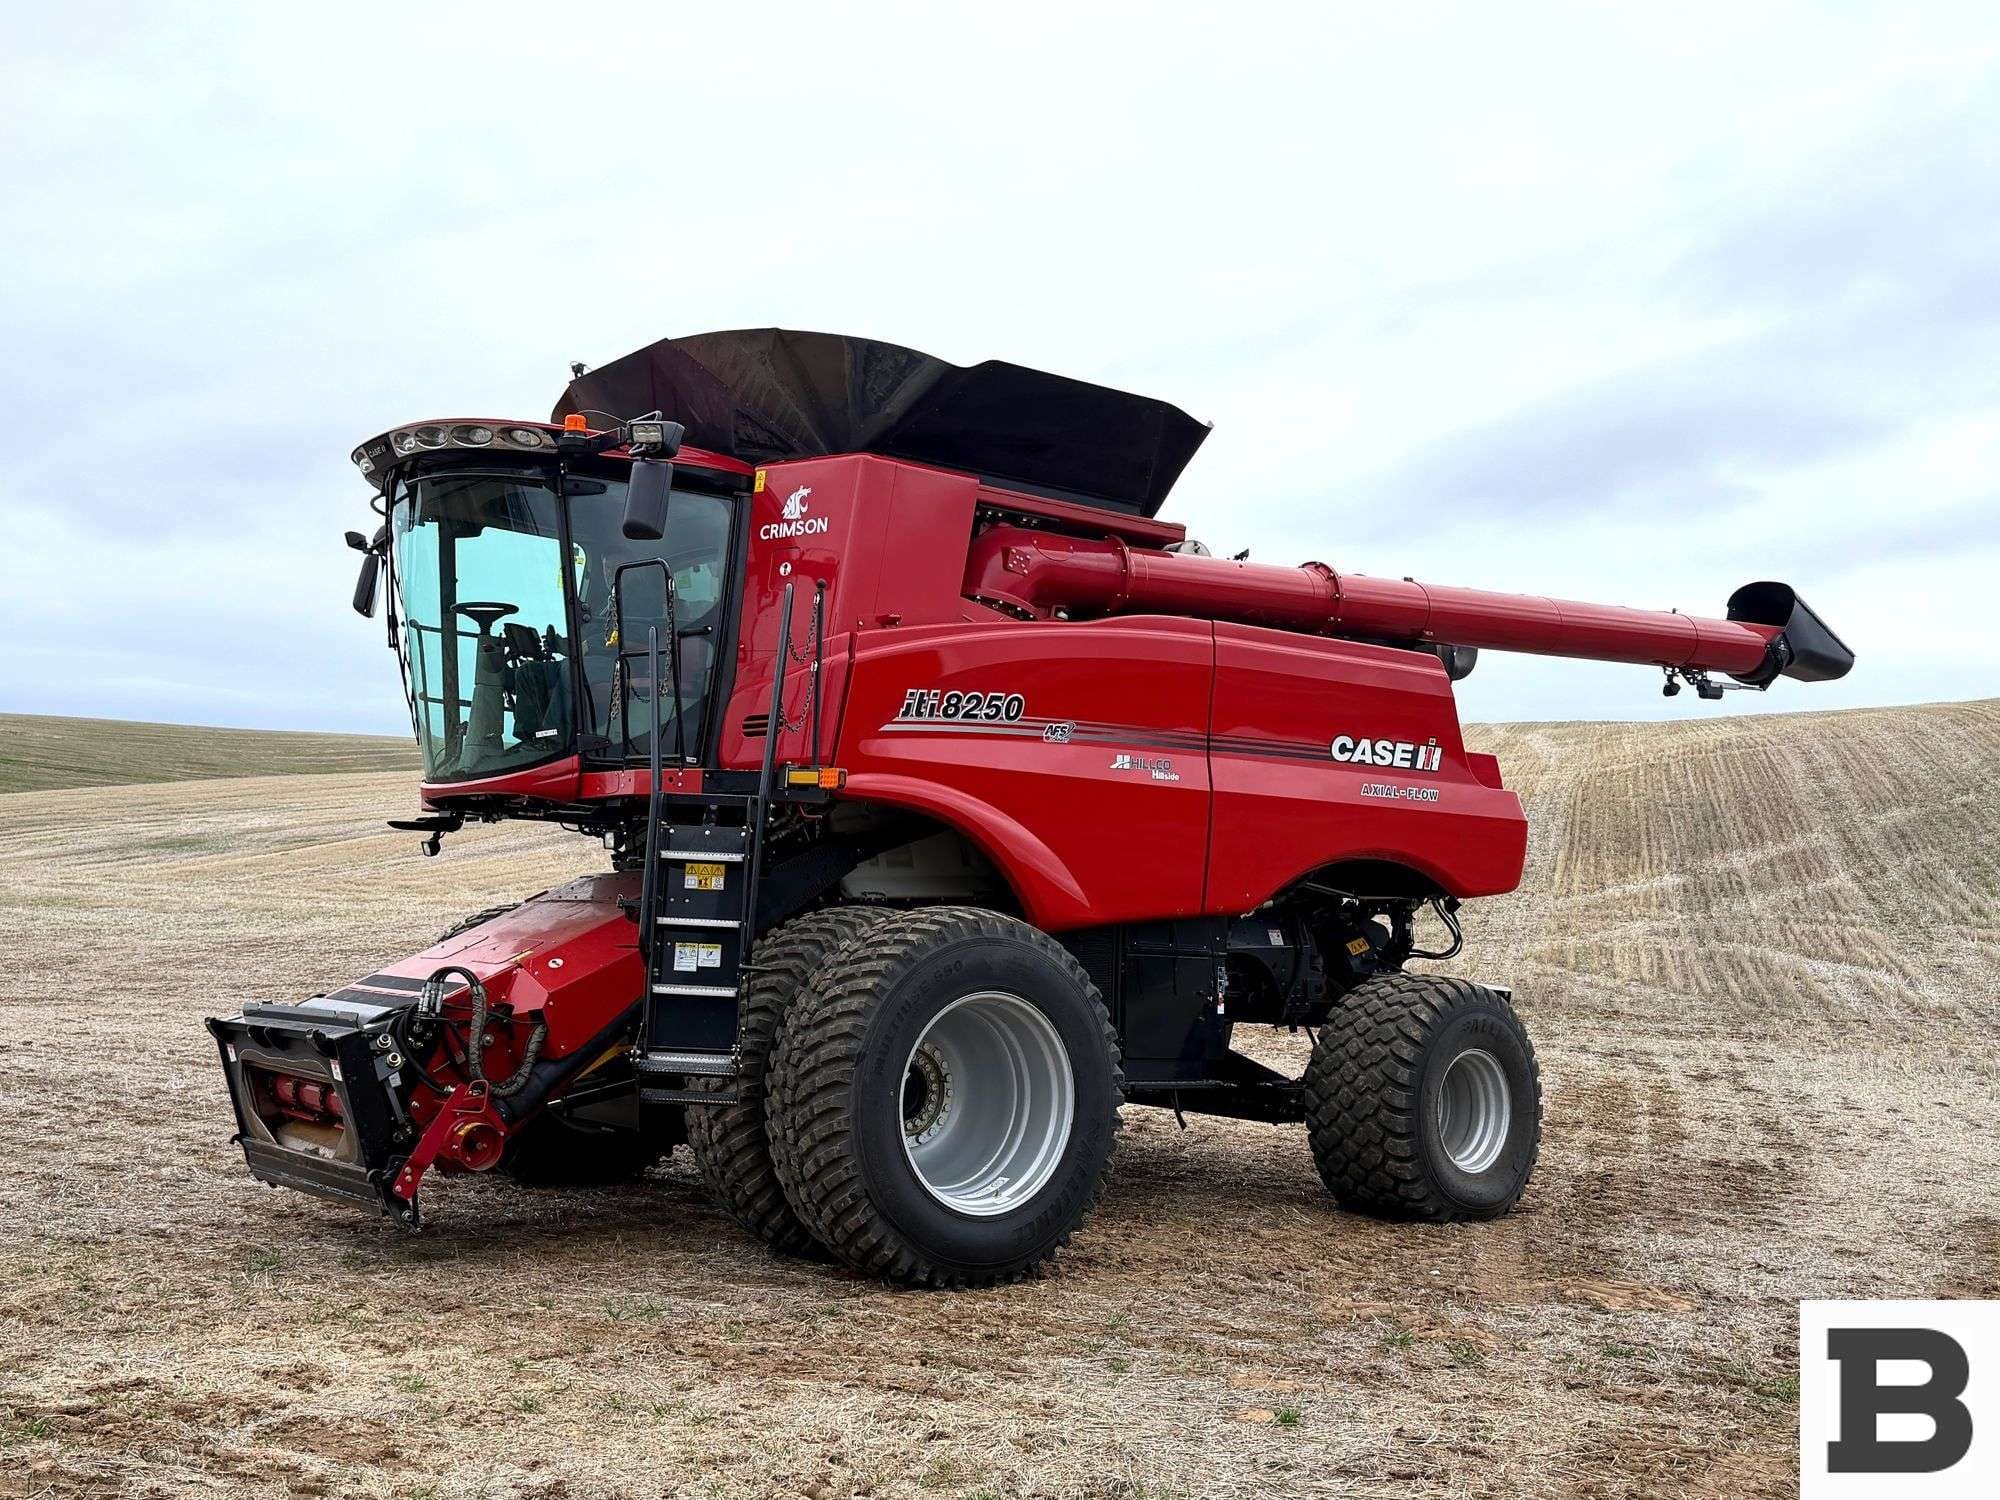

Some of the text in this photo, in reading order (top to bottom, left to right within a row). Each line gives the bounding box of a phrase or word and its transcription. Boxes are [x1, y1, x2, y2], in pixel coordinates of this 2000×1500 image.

[760, 517, 828, 540] CRIMSON
[940, 691, 1025, 722] 8250
[1043, 723, 1070, 736] AFS
[1331, 735, 1415, 768] CASE
[1131, 758, 1171, 770] HILLCO
[1361, 783, 1440, 802] AXIAL-FLOW
